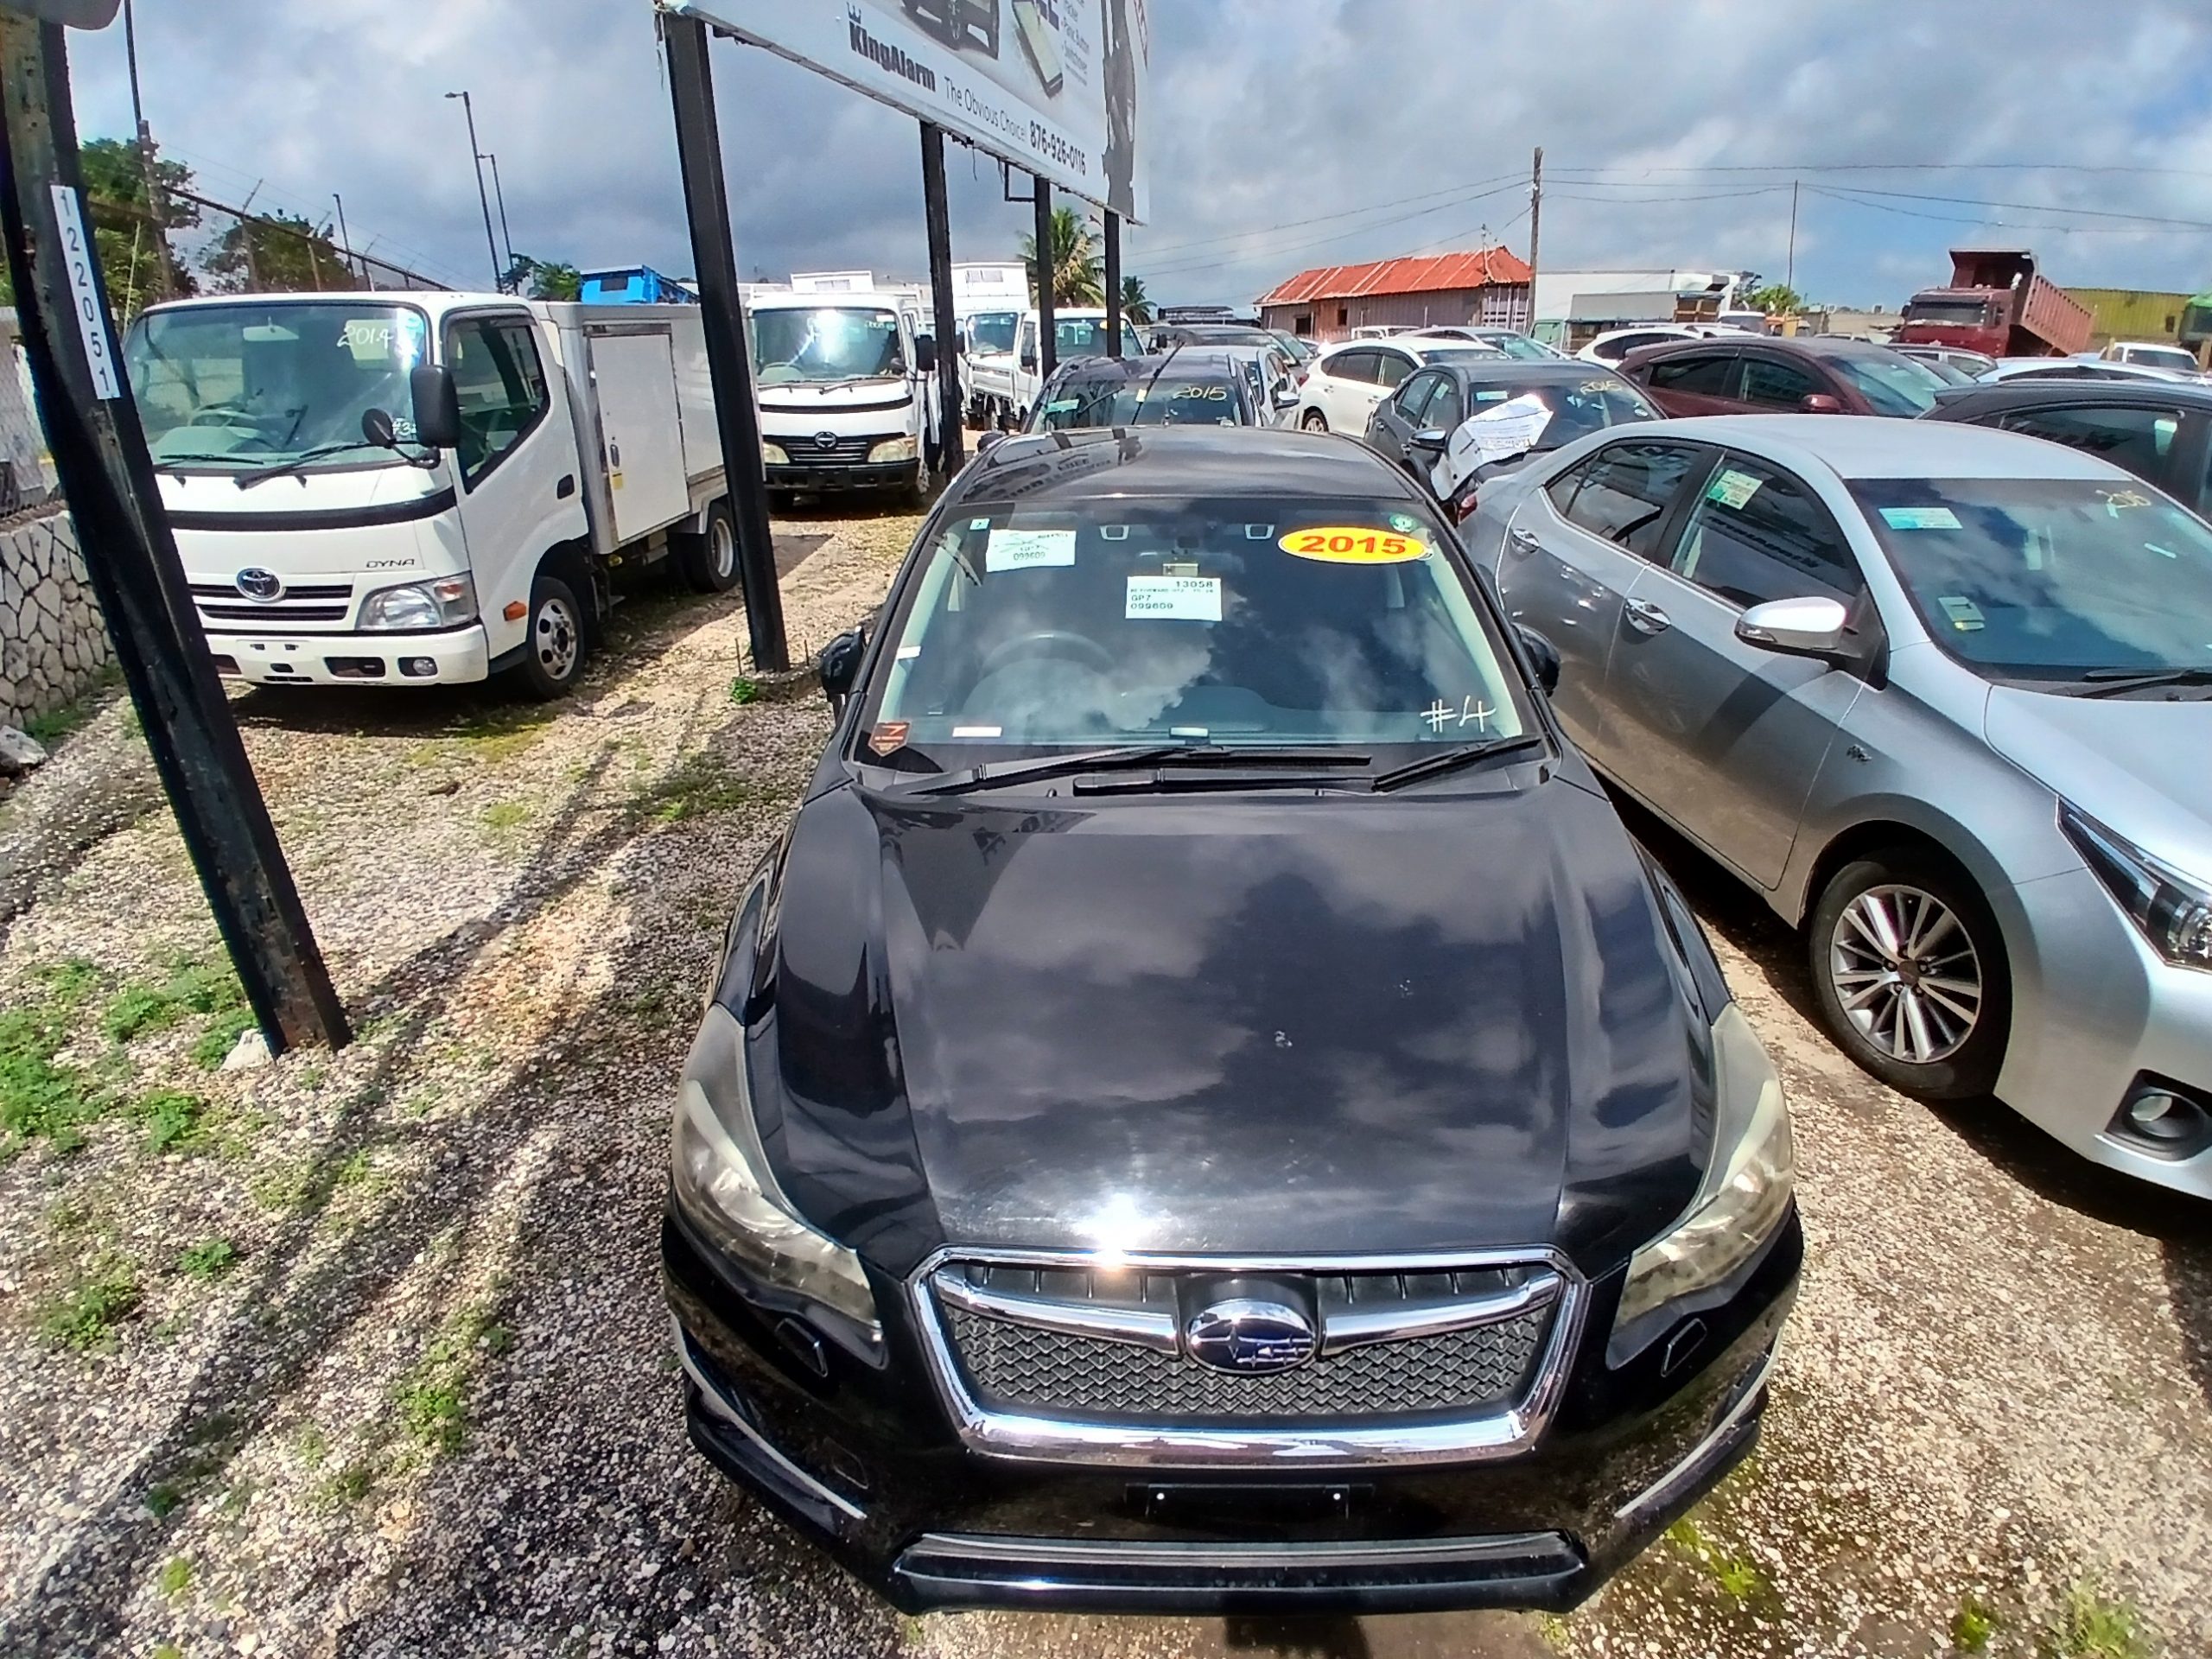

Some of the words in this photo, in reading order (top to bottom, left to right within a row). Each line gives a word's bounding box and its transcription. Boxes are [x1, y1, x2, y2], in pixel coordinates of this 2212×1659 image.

[849, 21, 936, 92] KingAlarm
[944, 76, 963, 107] The
[965, 88, 999, 127] Obvious
[60, 189, 110, 391] 122051
[1173, 385, 1227, 401] 2015
[1299, 536, 1406, 555] 2015
[366, 558, 415, 569] DYNA
[1420, 695, 1497, 733] #4
